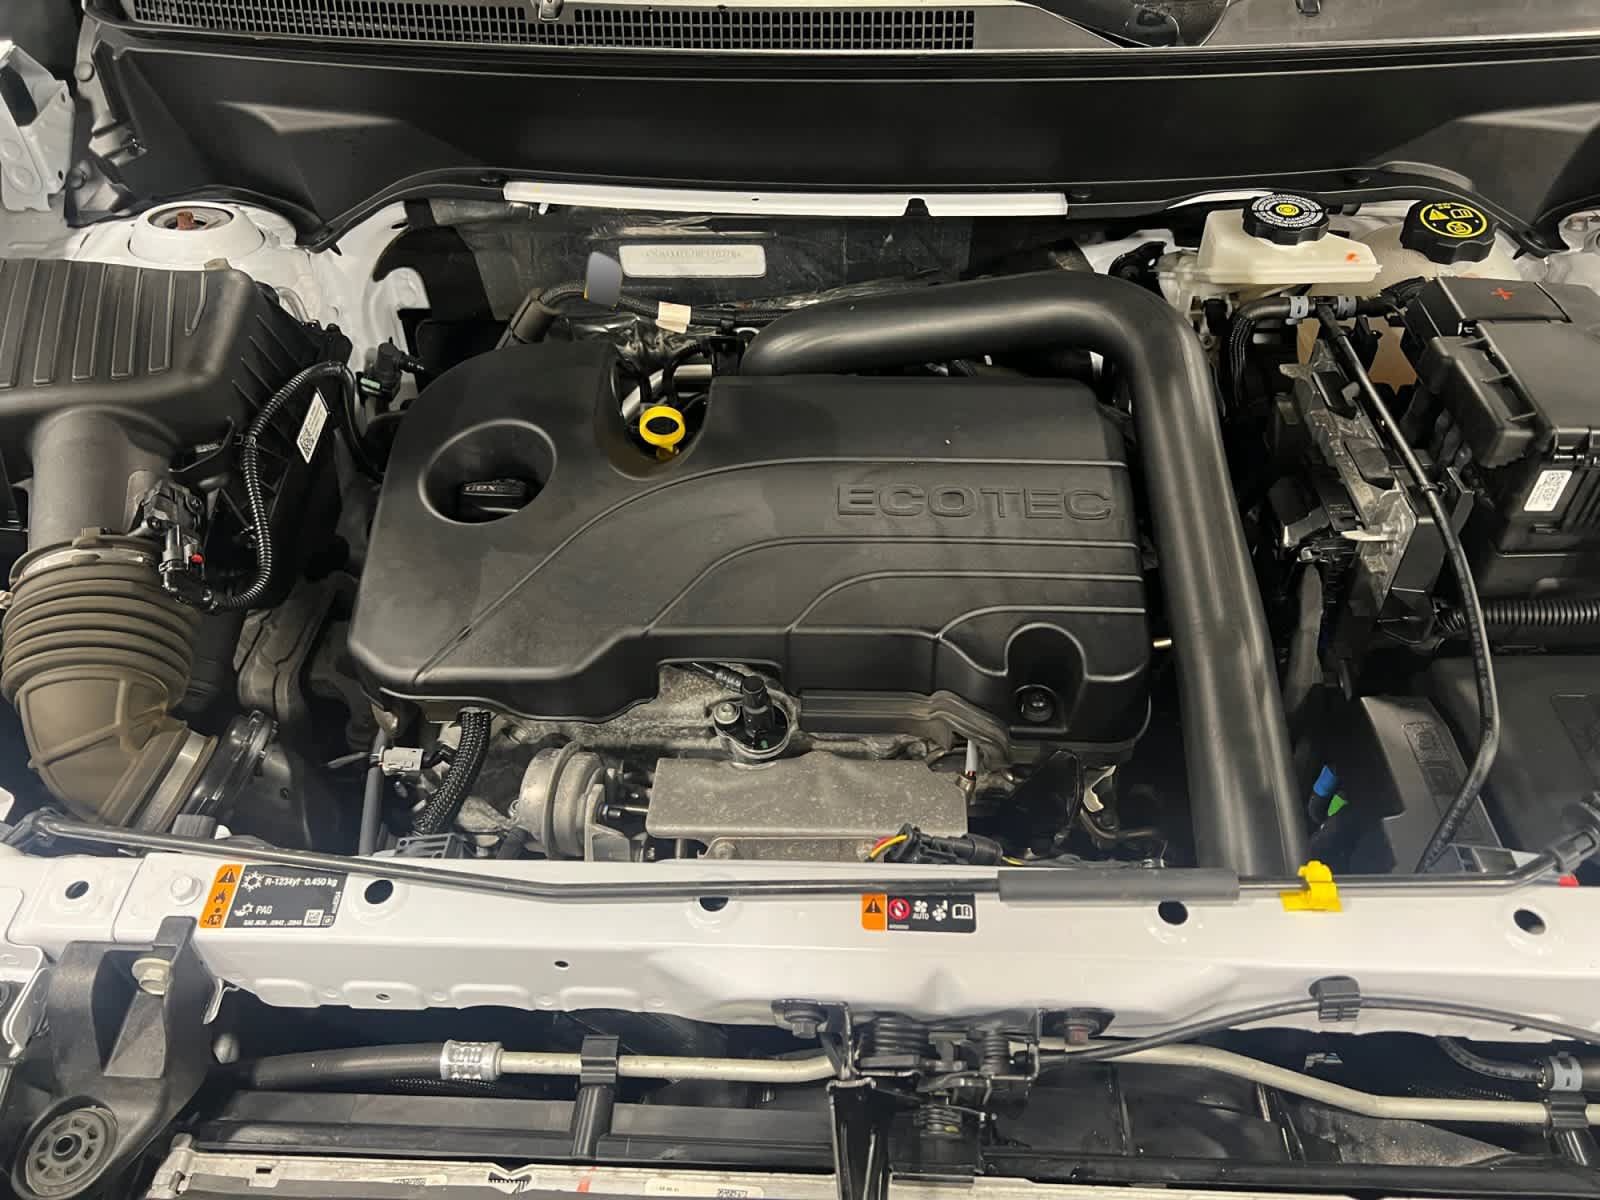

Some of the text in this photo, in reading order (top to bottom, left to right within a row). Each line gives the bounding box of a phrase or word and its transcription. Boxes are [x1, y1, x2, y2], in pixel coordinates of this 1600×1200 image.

[837, 484, 1113, 521] ECOTEC
[327, 877, 338, 889] kg
[256, 905, 273, 915] PAG
[912, 912, 930, 920] AUTO
